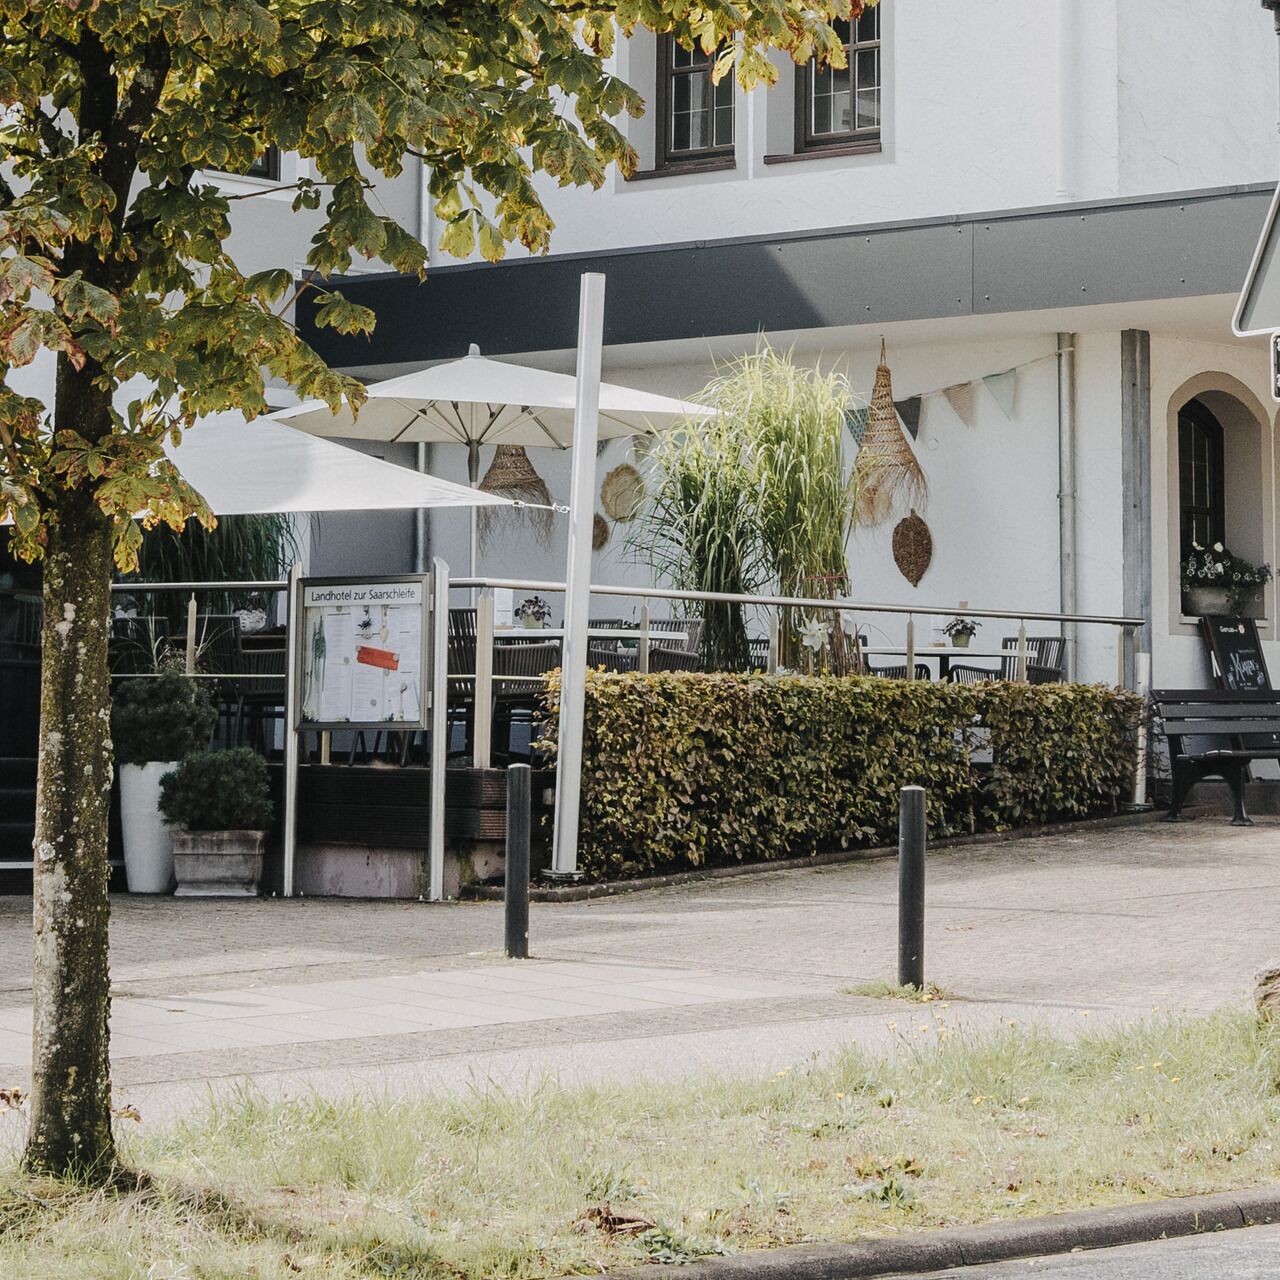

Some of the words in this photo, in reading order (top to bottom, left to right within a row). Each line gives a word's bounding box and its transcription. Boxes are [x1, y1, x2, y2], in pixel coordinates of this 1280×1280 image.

[311, 589, 352, 601] Landhotel
[354, 592, 367, 600] zur
[369, 588, 416, 600] Saarschleife
